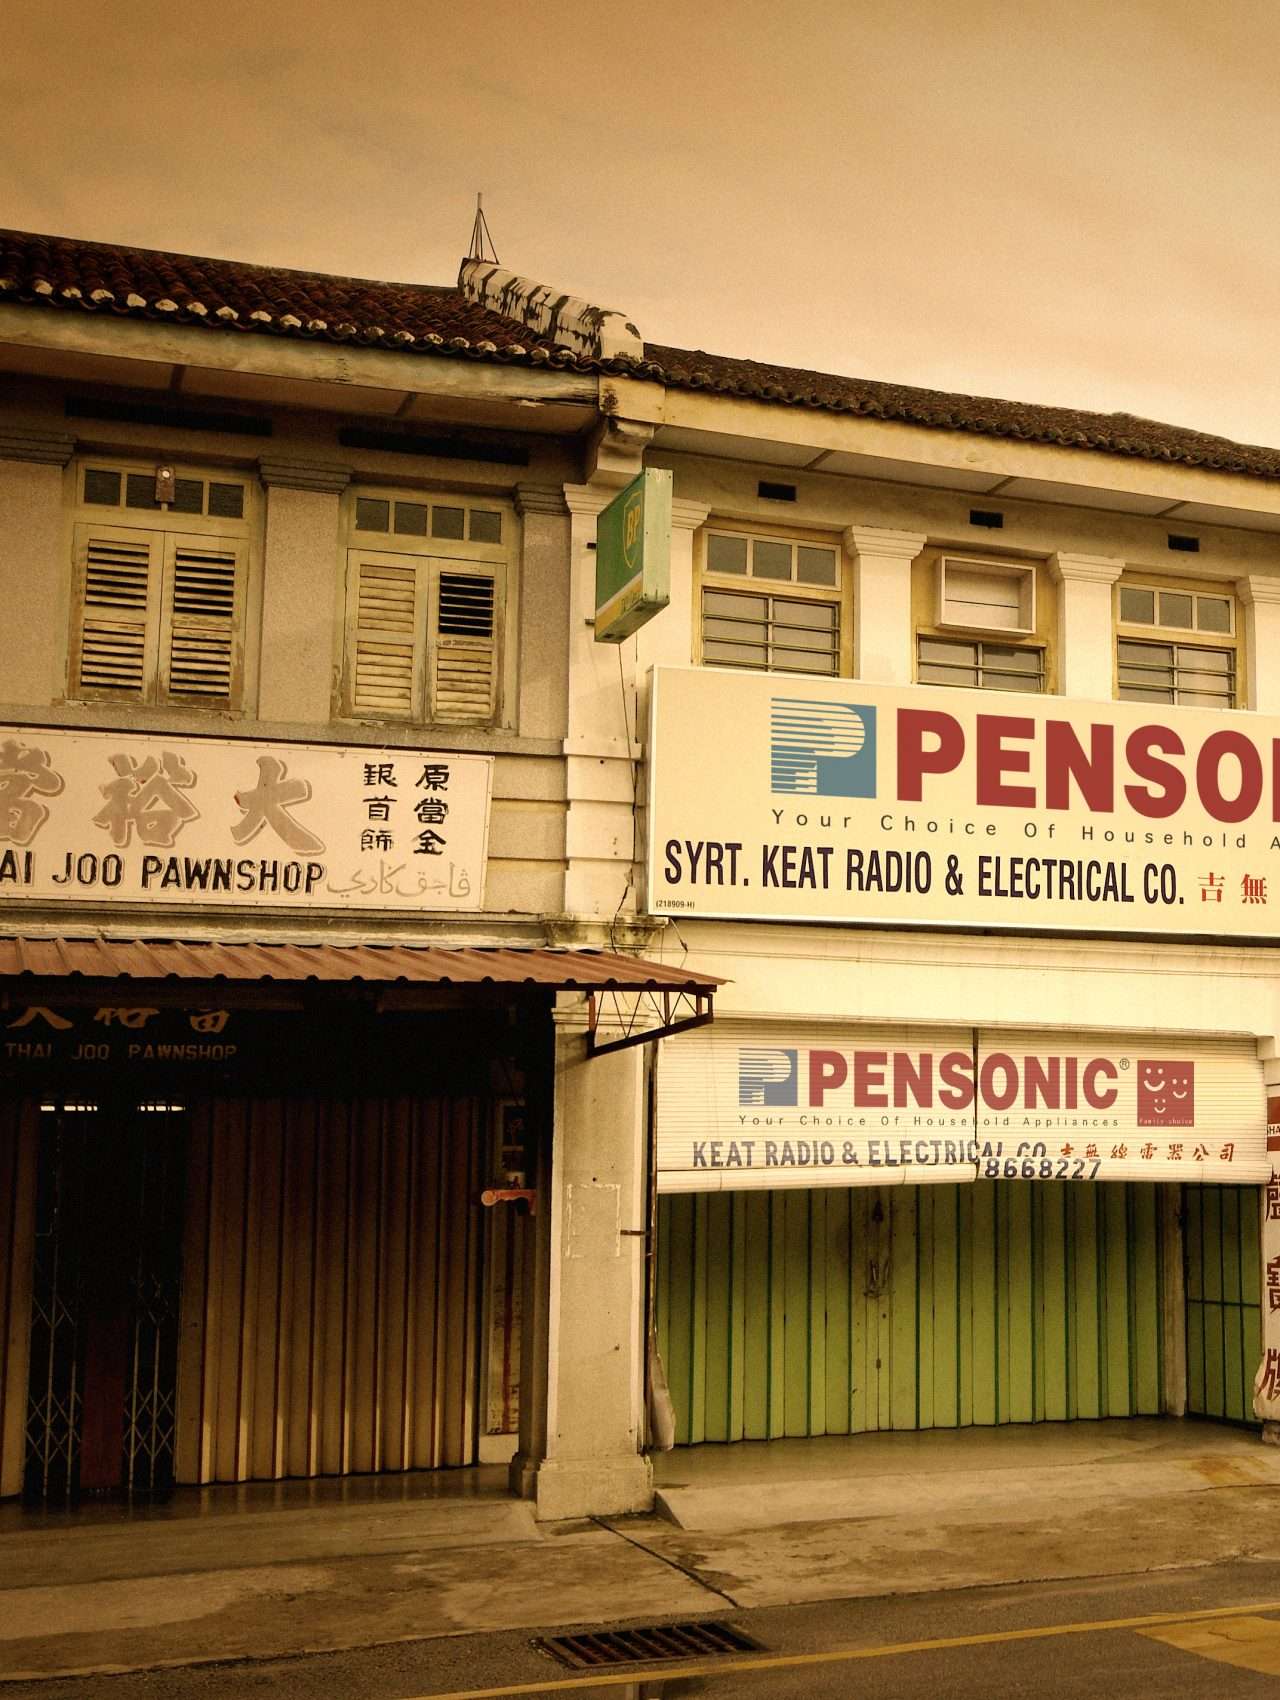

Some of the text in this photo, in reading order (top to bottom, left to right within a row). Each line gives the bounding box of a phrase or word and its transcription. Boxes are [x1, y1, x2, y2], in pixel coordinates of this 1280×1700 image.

[626, 504, 641, 550] BP
[772, 808, 852, 830] Your
[880, 813, 998, 838] Choice
[1024, 821, 1057, 840] Of
[1082, 825, 1247, 850] Household
[52, 852, 125, 887] JOO
[141, 855, 324, 895] PAWNSHOP
[664, 839, 1185, 906] SYRT. KEAT RADIO & ELECTRICAL CO.
[4, 1042, 240, 1063] THAI JOO PAWNSHOP
[809, 1049, 1119, 1111] PENSONIC
[738, 1115, 784, 1126] Your
[799, 1115, 866, 1126] Choice
[880, 1115, 900, 1126] Of
[1023, 1117, 1120, 1129] Appliances
[693, 1140, 755, 1168] KEAT
[765, 1140, 836, 1167] RADIO
[842, 1140, 859, 1165] &
[984, 1158, 1102, 1179] 8668227
